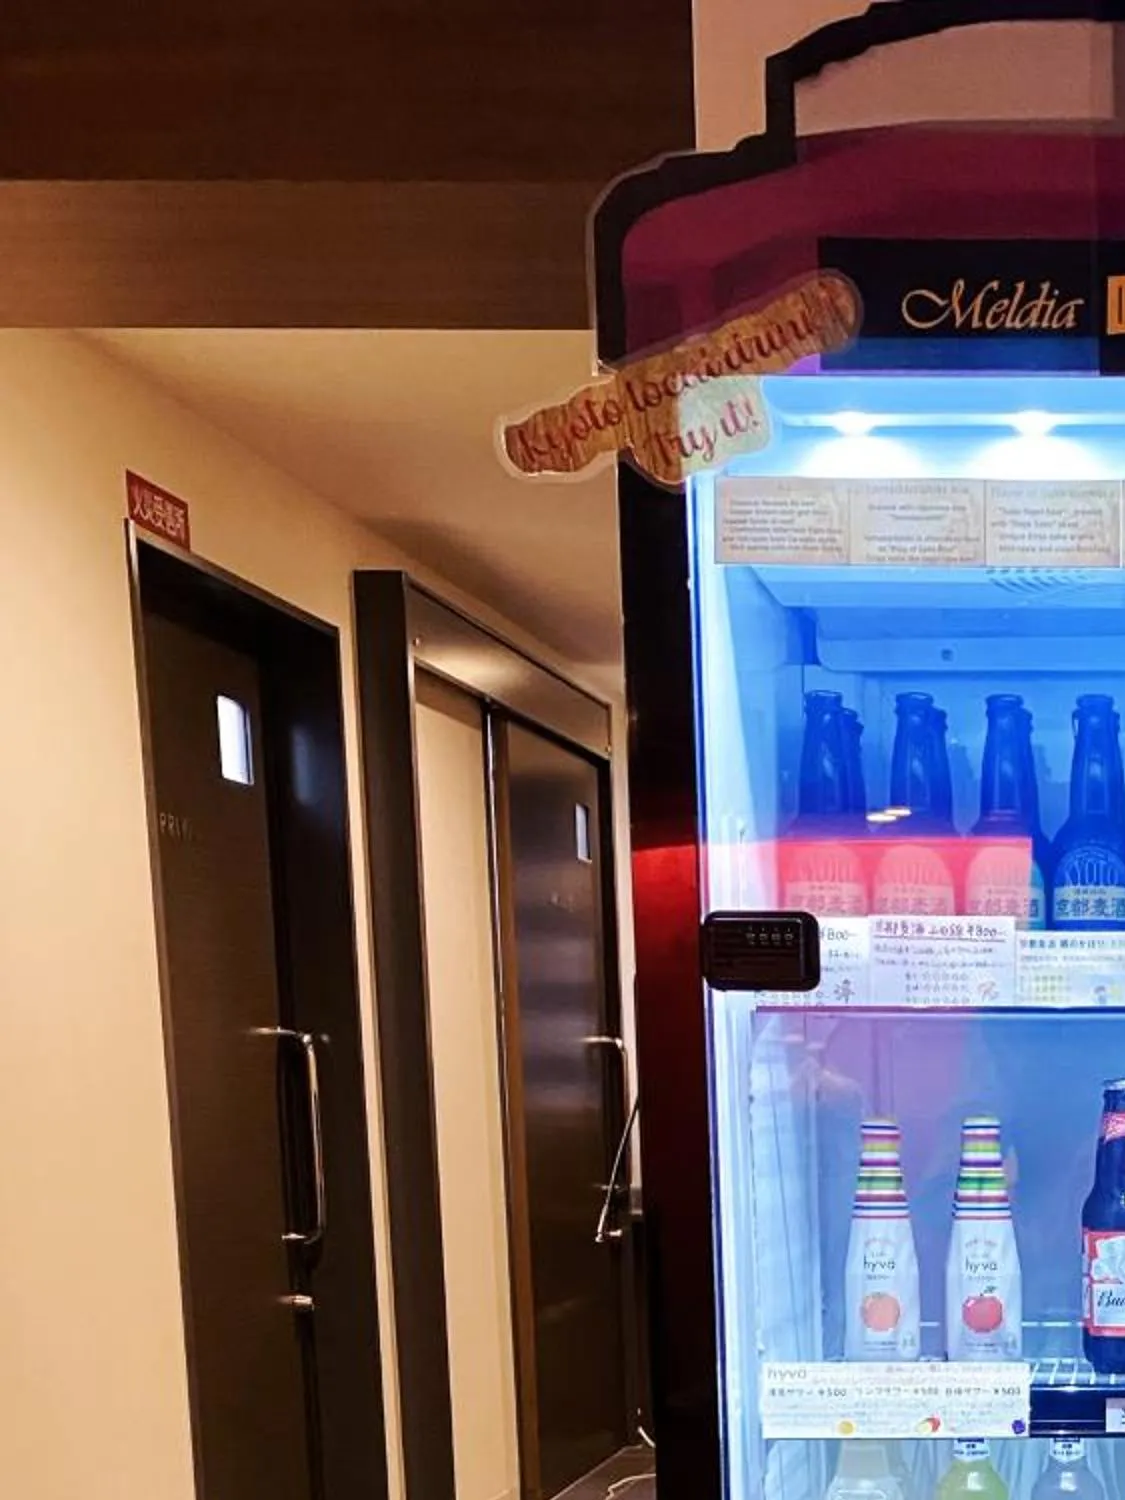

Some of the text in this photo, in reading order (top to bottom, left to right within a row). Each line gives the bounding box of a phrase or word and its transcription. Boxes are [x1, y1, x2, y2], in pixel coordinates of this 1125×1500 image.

[900, 278, 1084, 330] Meldia
[863, 1255, 896, 1272] hyva
[965, 1255, 998, 1272] hyva
